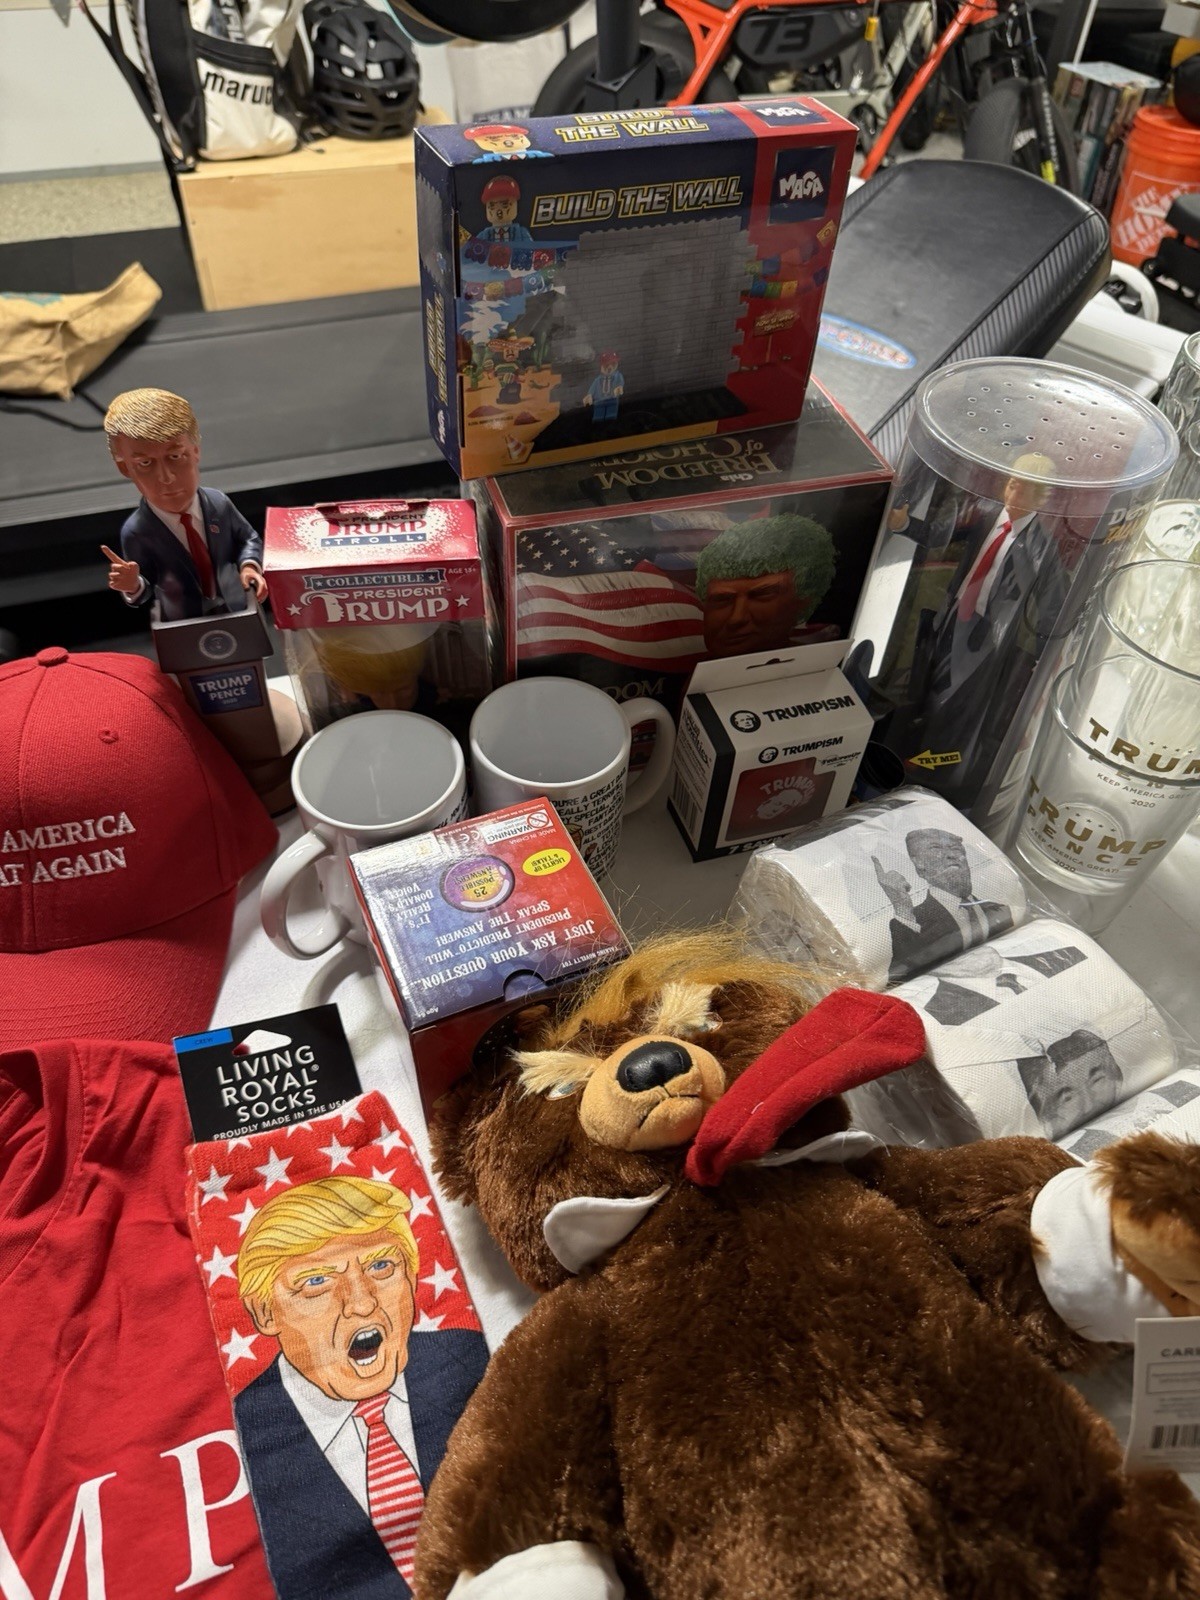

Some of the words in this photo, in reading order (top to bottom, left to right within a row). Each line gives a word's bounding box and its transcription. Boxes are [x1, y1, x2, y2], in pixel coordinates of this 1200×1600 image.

[750, 16, 813, 54] 73
[575, 109, 663, 125] BUILD
[756, 106, 811, 117] MAGA
[556, 123, 620, 142] THE
[621, 117, 709, 137] WALL
[779, 171, 824, 200] MAGA
[531, 188, 616, 227] BUILD
[618, 183, 674, 218] THE
[673, 176, 743, 212] WALL
[744, 440, 763, 455] of
[596, 452, 782, 489] FREEDOM
[720, 473, 754, 483] Chia
[310, 518, 427, 536] TRUMP
[352, 514, 426, 523] PRESIDENT
[334, 535, 413, 545] TROLL
[326, 573, 425, 588] COLLECTIBLE
[353, 586, 445, 599] PRESIDENT
[301, 591, 449, 623] TRUMP
[197, 675, 252, 693] TRUMP
[210, 687, 247, 701] PENCE
[763, 696, 856, 722] TRUMPISM
[782, 736, 844, 756] TRUMPISM
[918, 757, 939, 765] TRY
[940, 754, 959, 763] ME!
[581, 795, 588, 803] A
[590, 779, 616, 800] GREAT
[1097, 773, 1120, 787] KEEP
[1122, 786, 1165, 799] AMERICA
[1131, 799, 1155, 808] 2020
[1028, 775, 1167, 855] TRUMP
[3, 811, 136, 853] AMERICA
[487, 824, 533, 842] WARNING
[509, 834, 531, 845] CHINA
[540, 828, 557, 837] MADE
[1027, 804, 1142, 867] PENCE
[1047, 843, 1084, 866] AMERICA
[32, 847, 127, 884] AGAIN
[543, 857, 566, 871] LIGHTS
[1054, 858, 1076, 873] 2020
[459, 875, 495, 892] POSSIBLE
[474, 886, 488, 898] 25
[388, 890, 434, 911] DONALD'S
[517, 900, 550, 918] SPEAK
[397, 903, 431, 921] REALLY
[410, 913, 431, 929] IT'S
[489, 911, 515, 925] THE
[516, 907, 572, 934] PRESIDENT
[437, 916, 484, 945] ANSWER!
[565, 920, 595, 943] JUST
[534, 933, 557, 951] ASK
[425, 949, 454, 965] WILL
[493, 943, 528, 965] YOUR
[574, 953, 597, 964] NOVELTY
[409, 955, 487, 990] QUESTION...
[426, 1007, 439, 1015] Age
[217, 1045, 315, 1085] LIVING
[236, 1089, 317, 1123] SOCKS
[213, 1123, 259, 1140] PROUDLY
[262, 1115, 290, 1128] MADE
[293, 1111, 304, 1120] IN
[308, 1106, 327, 1116] THE
[329, 1099, 348, 1111] USA
